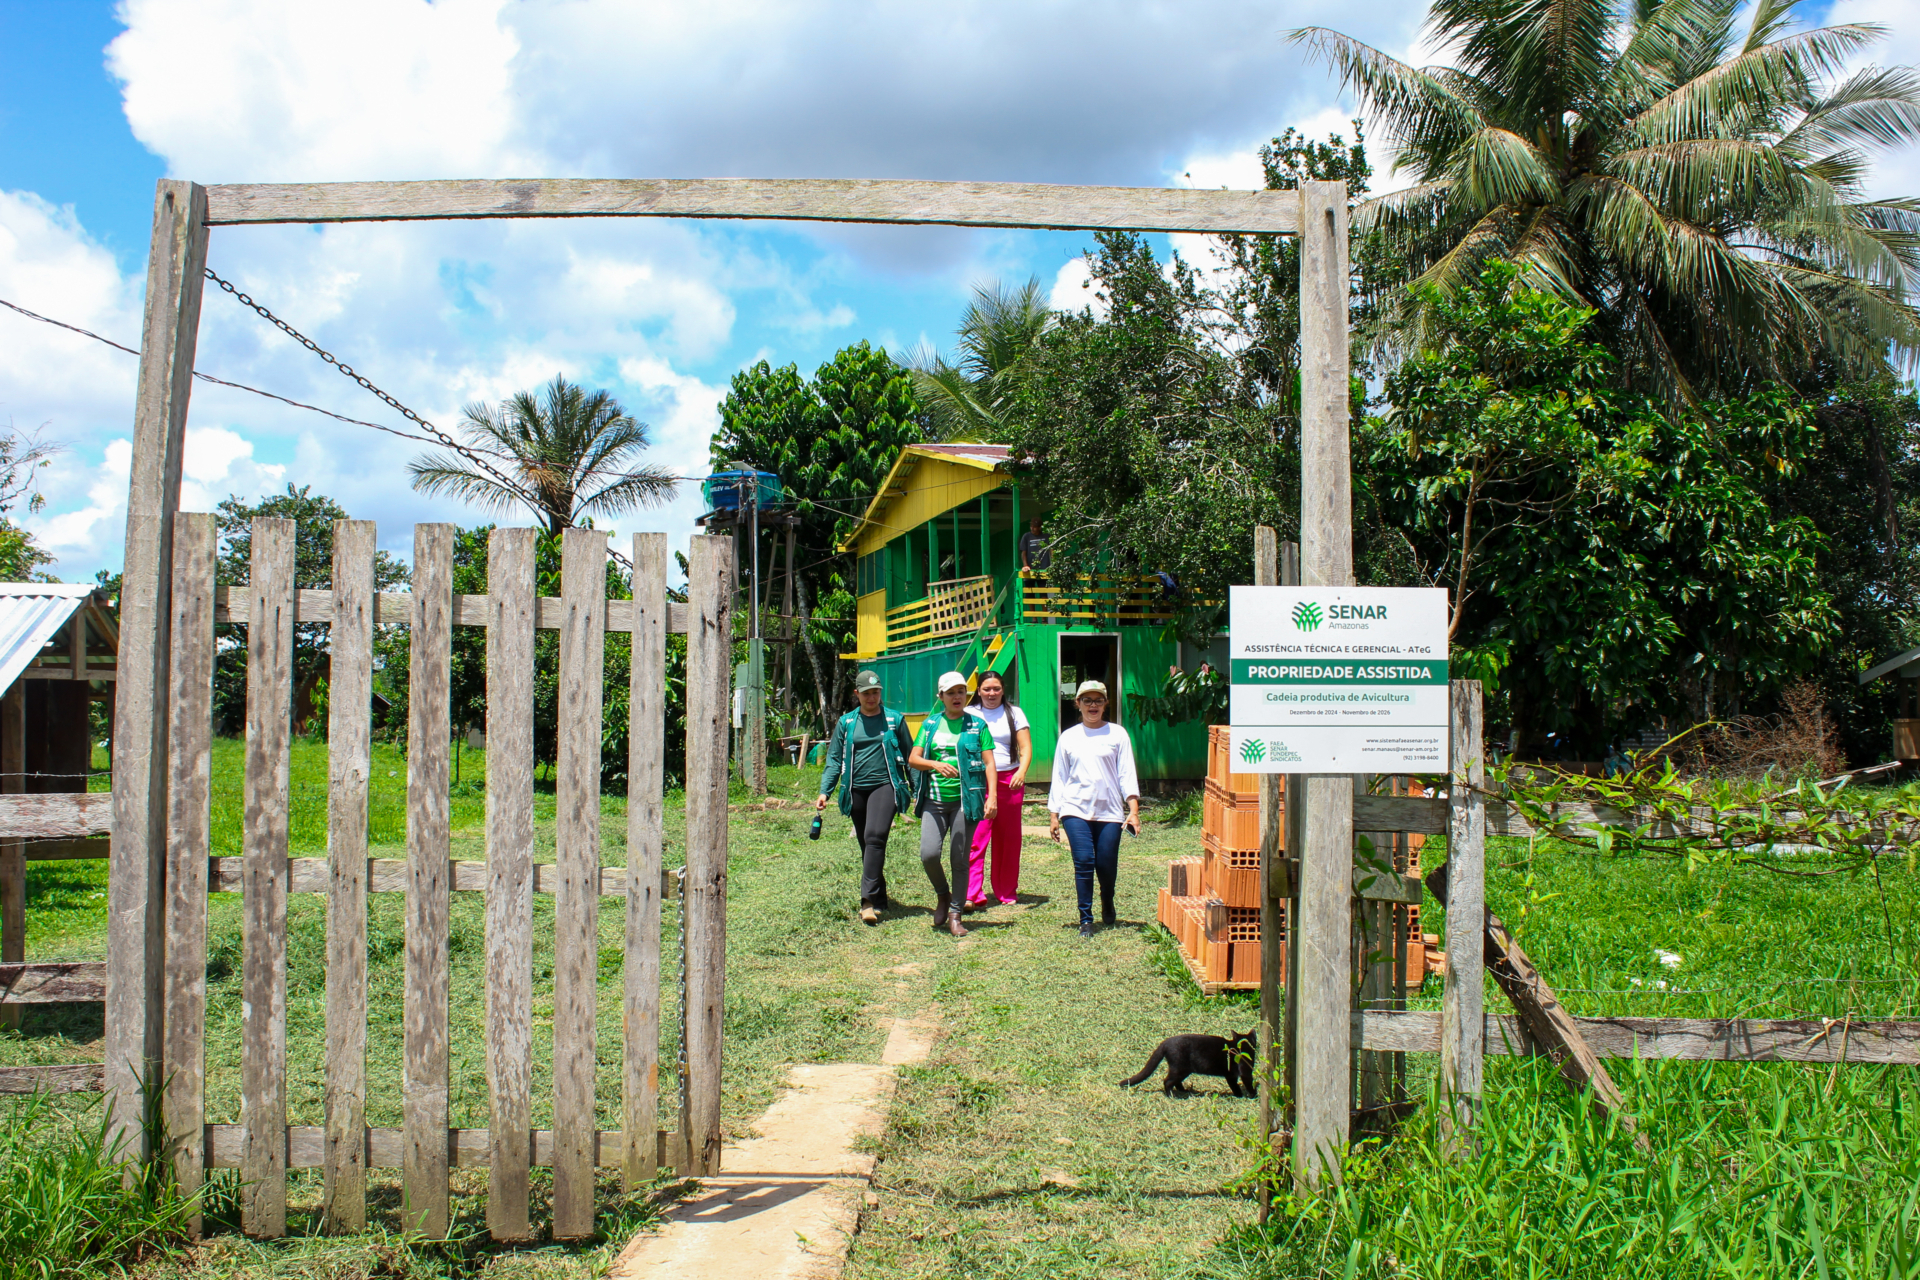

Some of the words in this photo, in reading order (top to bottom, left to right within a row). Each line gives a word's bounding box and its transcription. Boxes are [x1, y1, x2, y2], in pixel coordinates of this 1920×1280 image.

[1328, 605, 1388, 620] SENAR
[1328, 621, 1370, 630] Amazonas
[1244, 643, 1302, 653] ASSISTÊNCIA
[1304, 643, 1343, 653] TÉCNICA
[1344, 645, 1350, 653] E
[1352, 645, 1401, 654] GERENCIAL
[1408, 645, 1431, 654] ATeG
[1248, 666, 1353, 679] PROPRIEDADE
[1356, 666, 1432, 679] ASSISTIDA
[1266, 692, 1298, 702] Cadeia
[1300, 692, 1346, 705] produtiva
[1347, 692, 1359, 702] de
[1361, 693, 1410, 702] Avicultura
